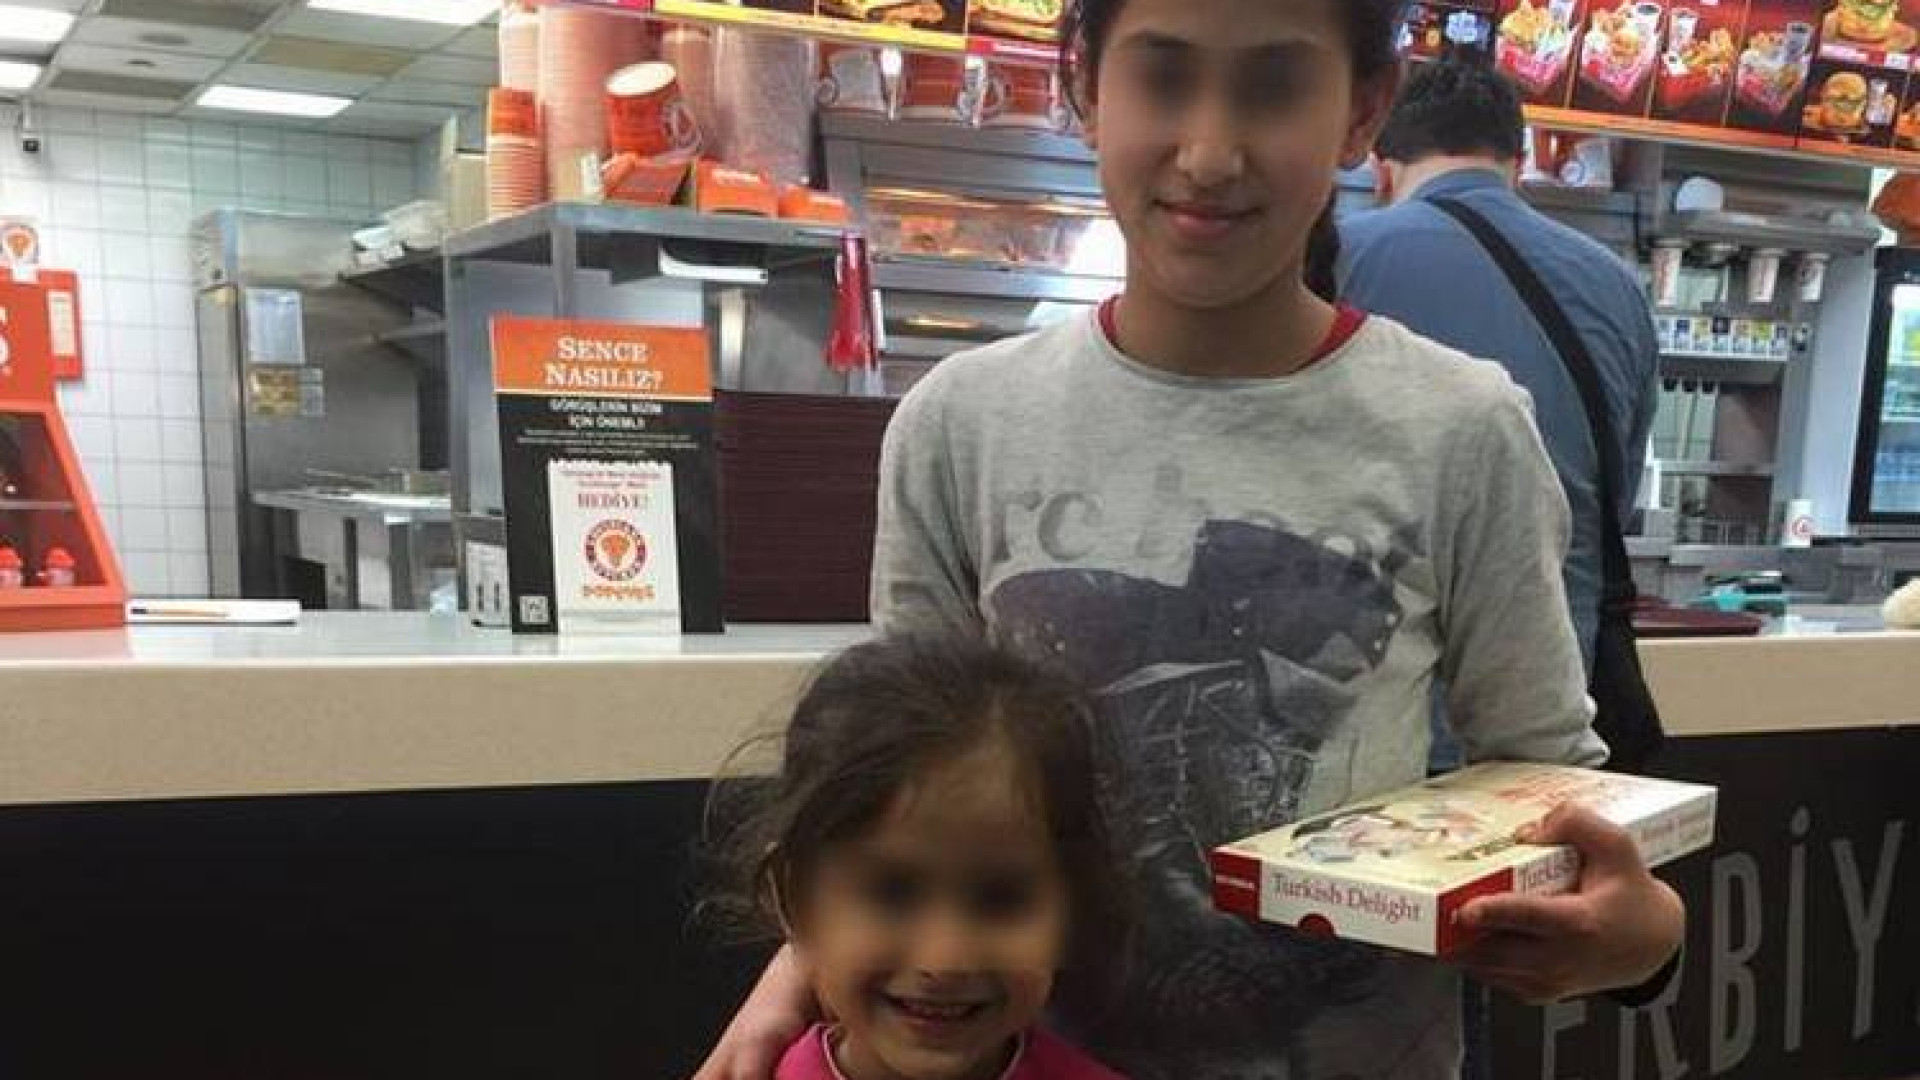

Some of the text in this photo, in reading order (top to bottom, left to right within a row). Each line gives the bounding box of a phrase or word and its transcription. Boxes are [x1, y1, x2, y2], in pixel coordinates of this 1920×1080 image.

[558, 336, 648, 361] SENCE
[545, 363, 663, 390] NASILIZ?
[1272, 872, 1344, 906] Turkish
[1348, 887, 1422, 925] Delight
